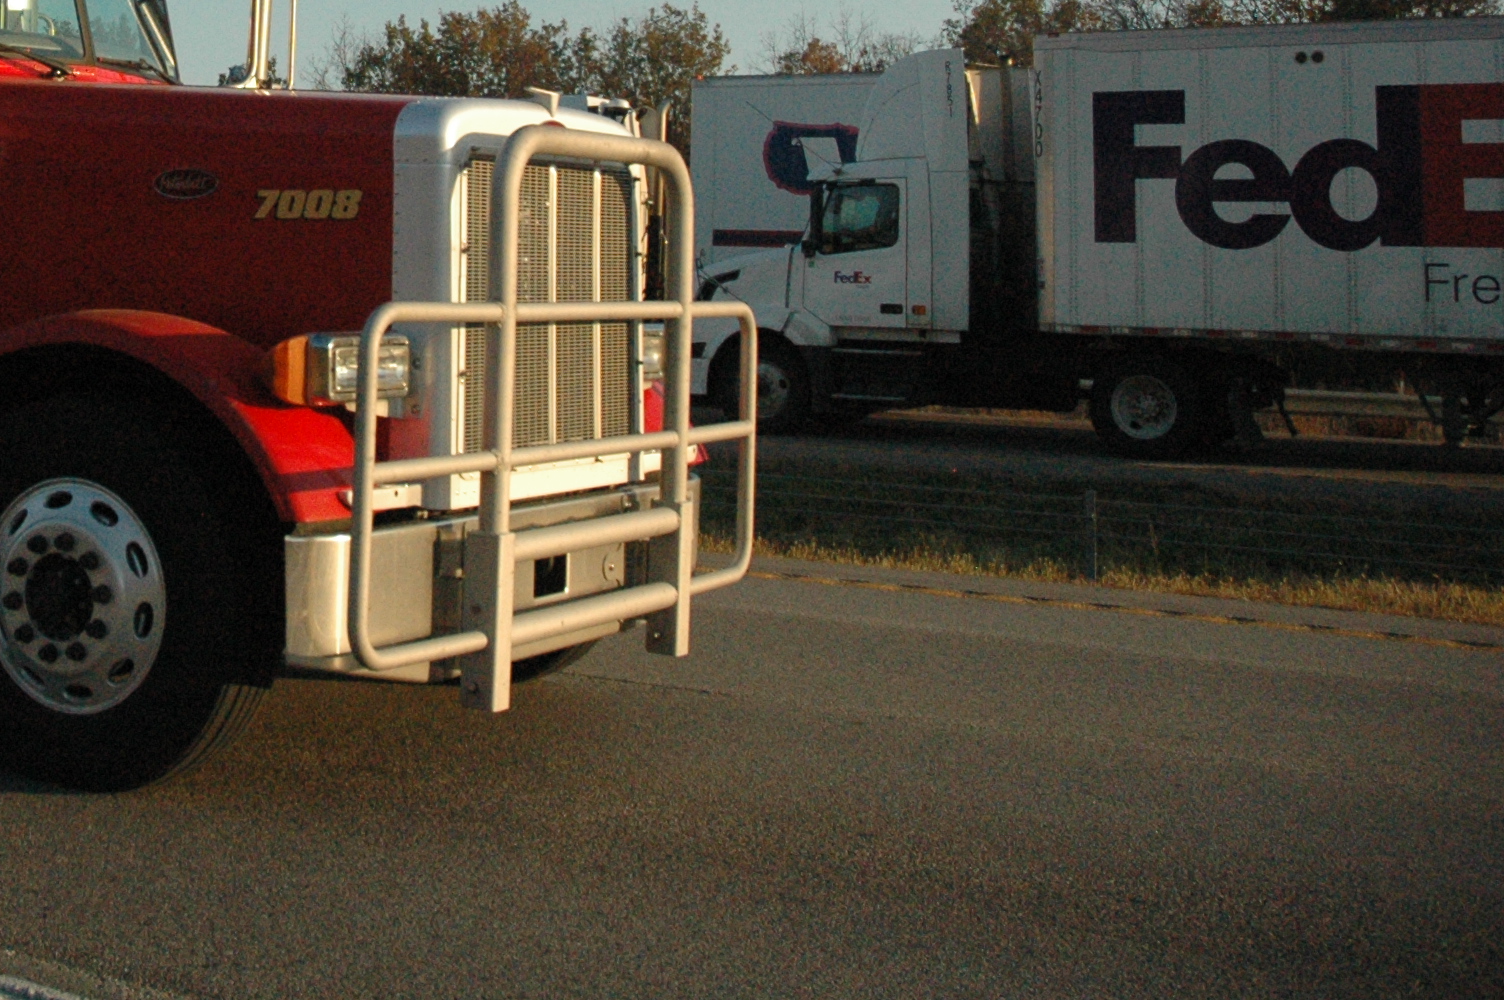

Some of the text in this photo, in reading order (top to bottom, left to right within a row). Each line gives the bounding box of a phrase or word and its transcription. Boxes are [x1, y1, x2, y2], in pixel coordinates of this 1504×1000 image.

[1035, 70, 1043, 158] X4700
[1092, 83, 1504, 252] FedE
[252, 188, 364, 221] 7008
[833, 270, 872, 285] FedEx
[1424, 262, 1501, 305] Fre
